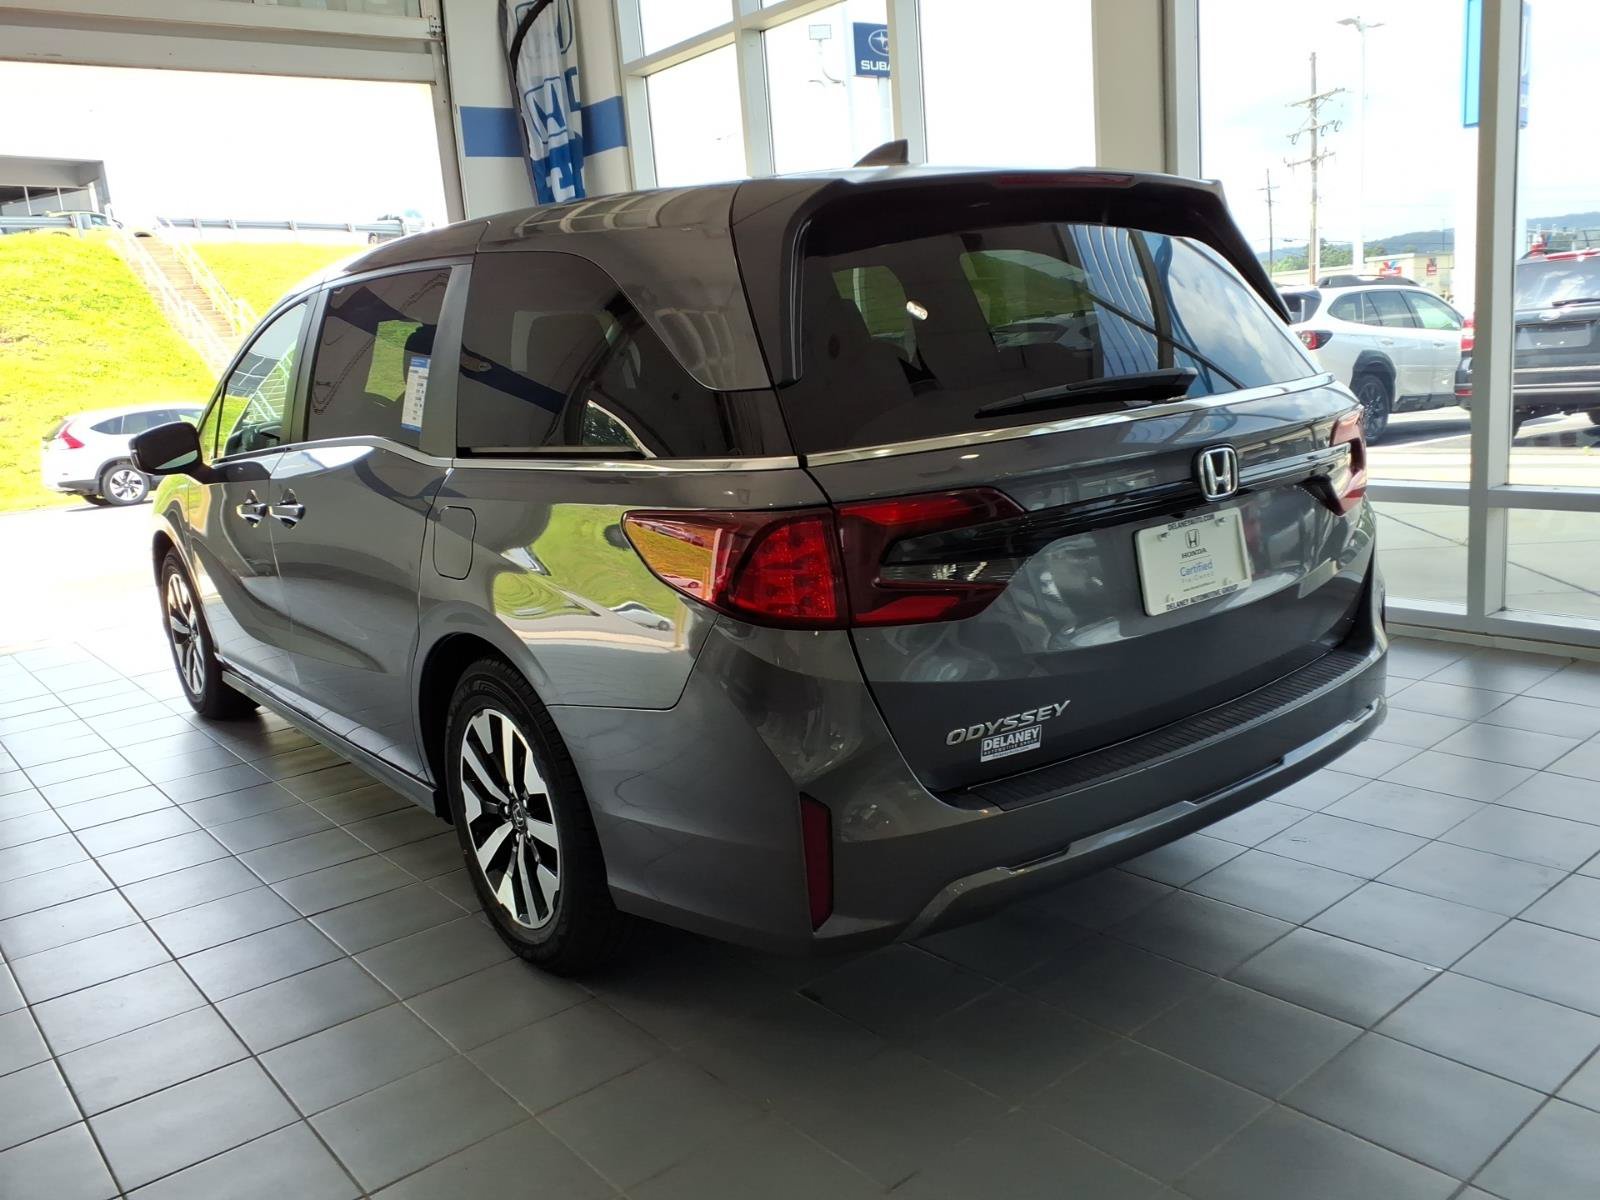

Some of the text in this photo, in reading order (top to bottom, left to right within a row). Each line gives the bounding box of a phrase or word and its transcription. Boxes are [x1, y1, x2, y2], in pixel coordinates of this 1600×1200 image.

[1181, 548, 1207, 559] HONDA
[1180, 560, 1213, 576] Certified
[946, 700, 1071, 745] ODYSSEY
[983, 727, 1040, 751] DELANEY
